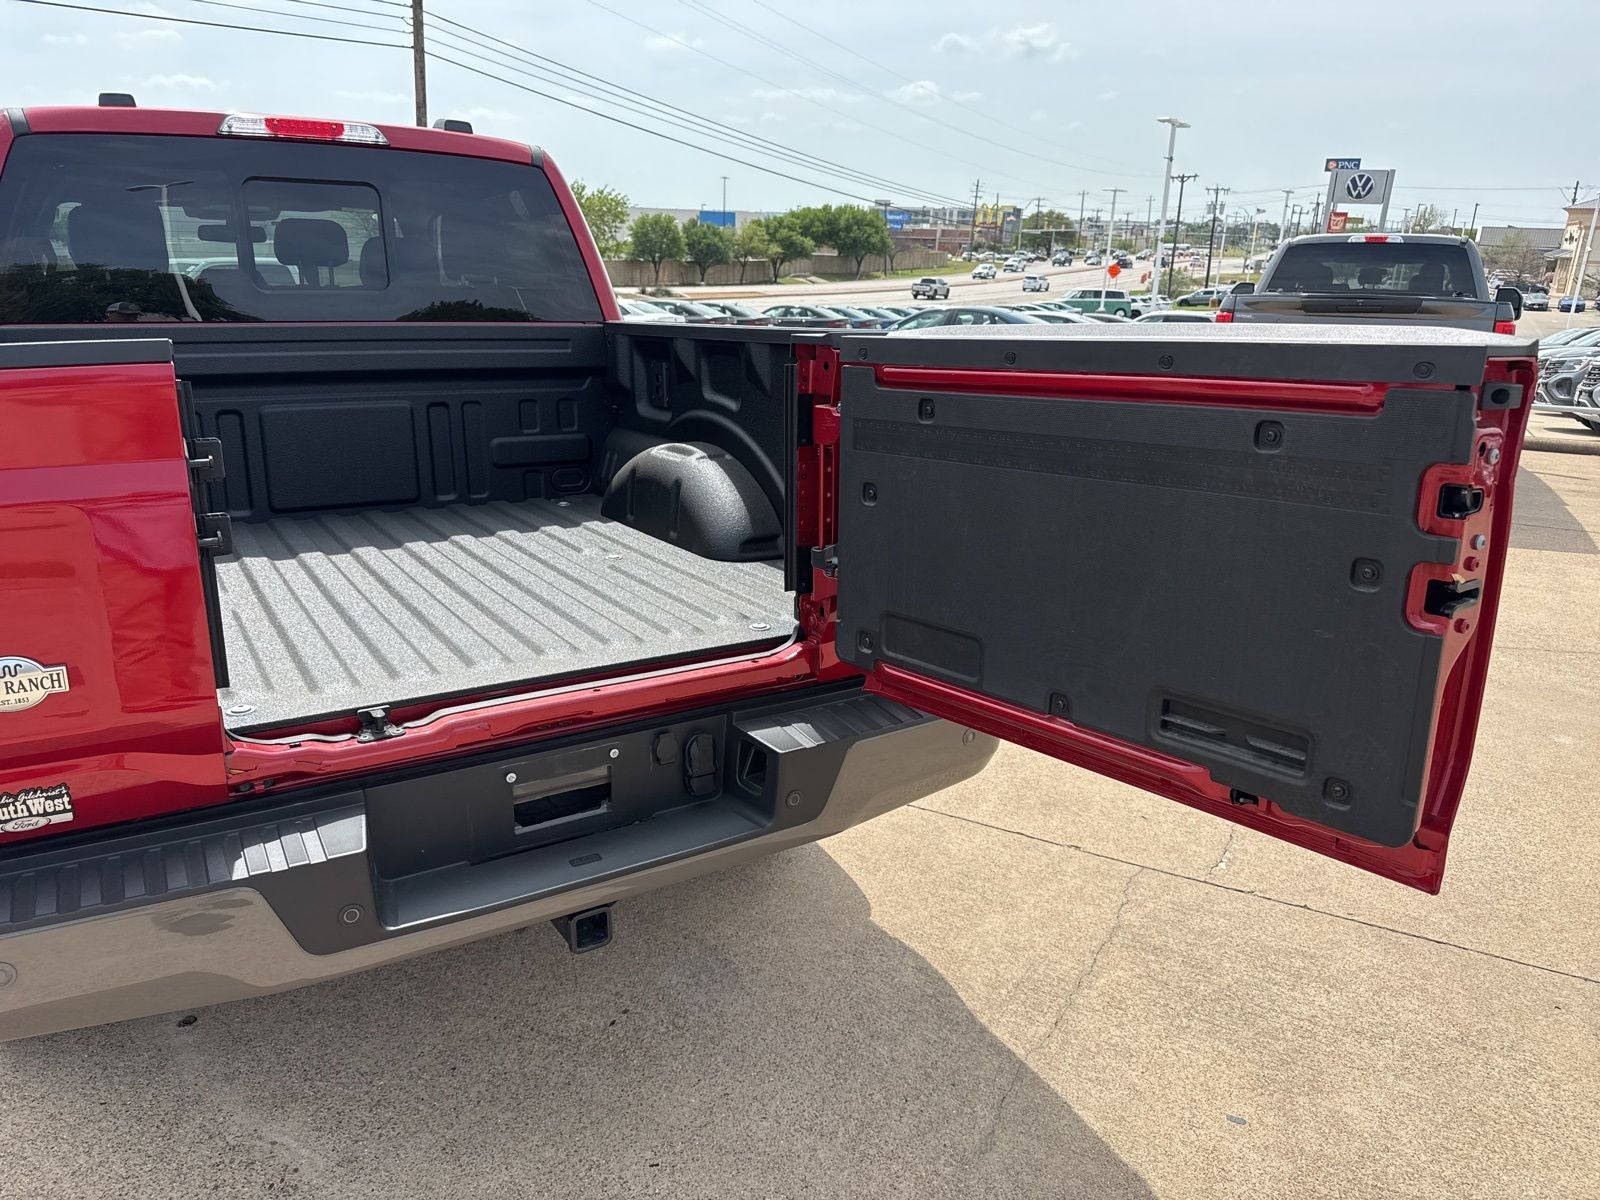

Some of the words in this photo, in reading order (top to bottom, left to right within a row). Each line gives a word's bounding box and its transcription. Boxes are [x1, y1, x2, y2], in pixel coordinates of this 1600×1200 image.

[1338, 161, 1359, 169] PNC
[4, 672, 63, 695] RANCH
[12, 819, 40, 830] Ford
